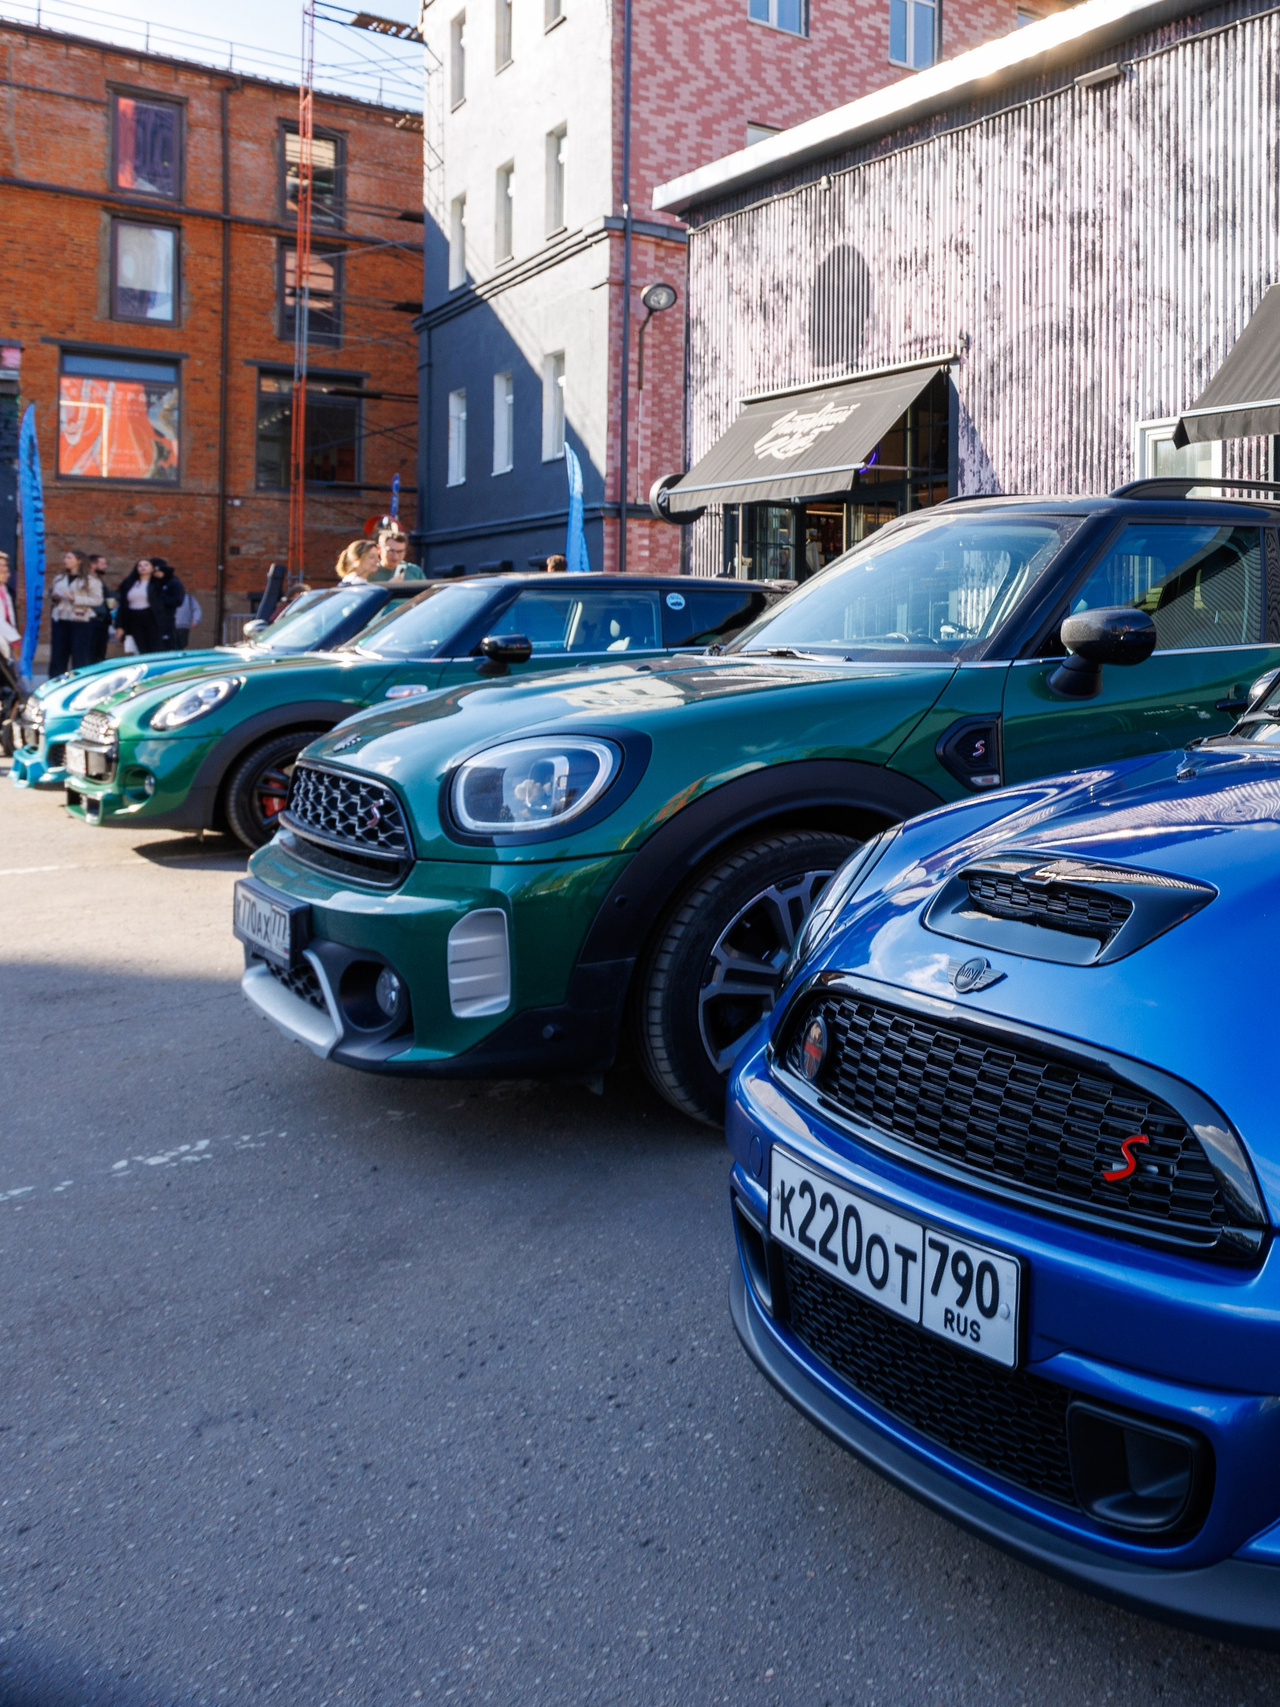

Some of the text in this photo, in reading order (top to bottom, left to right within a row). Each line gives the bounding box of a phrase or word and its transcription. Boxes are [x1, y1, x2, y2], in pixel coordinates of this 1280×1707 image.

[972, 739, 985, 757] S
[960, 965, 981, 981] MINI
[1102, 1133, 1150, 1183] S
[928, 1236, 1000, 1320] 790
[943, 1307, 982, 1344] RUS
